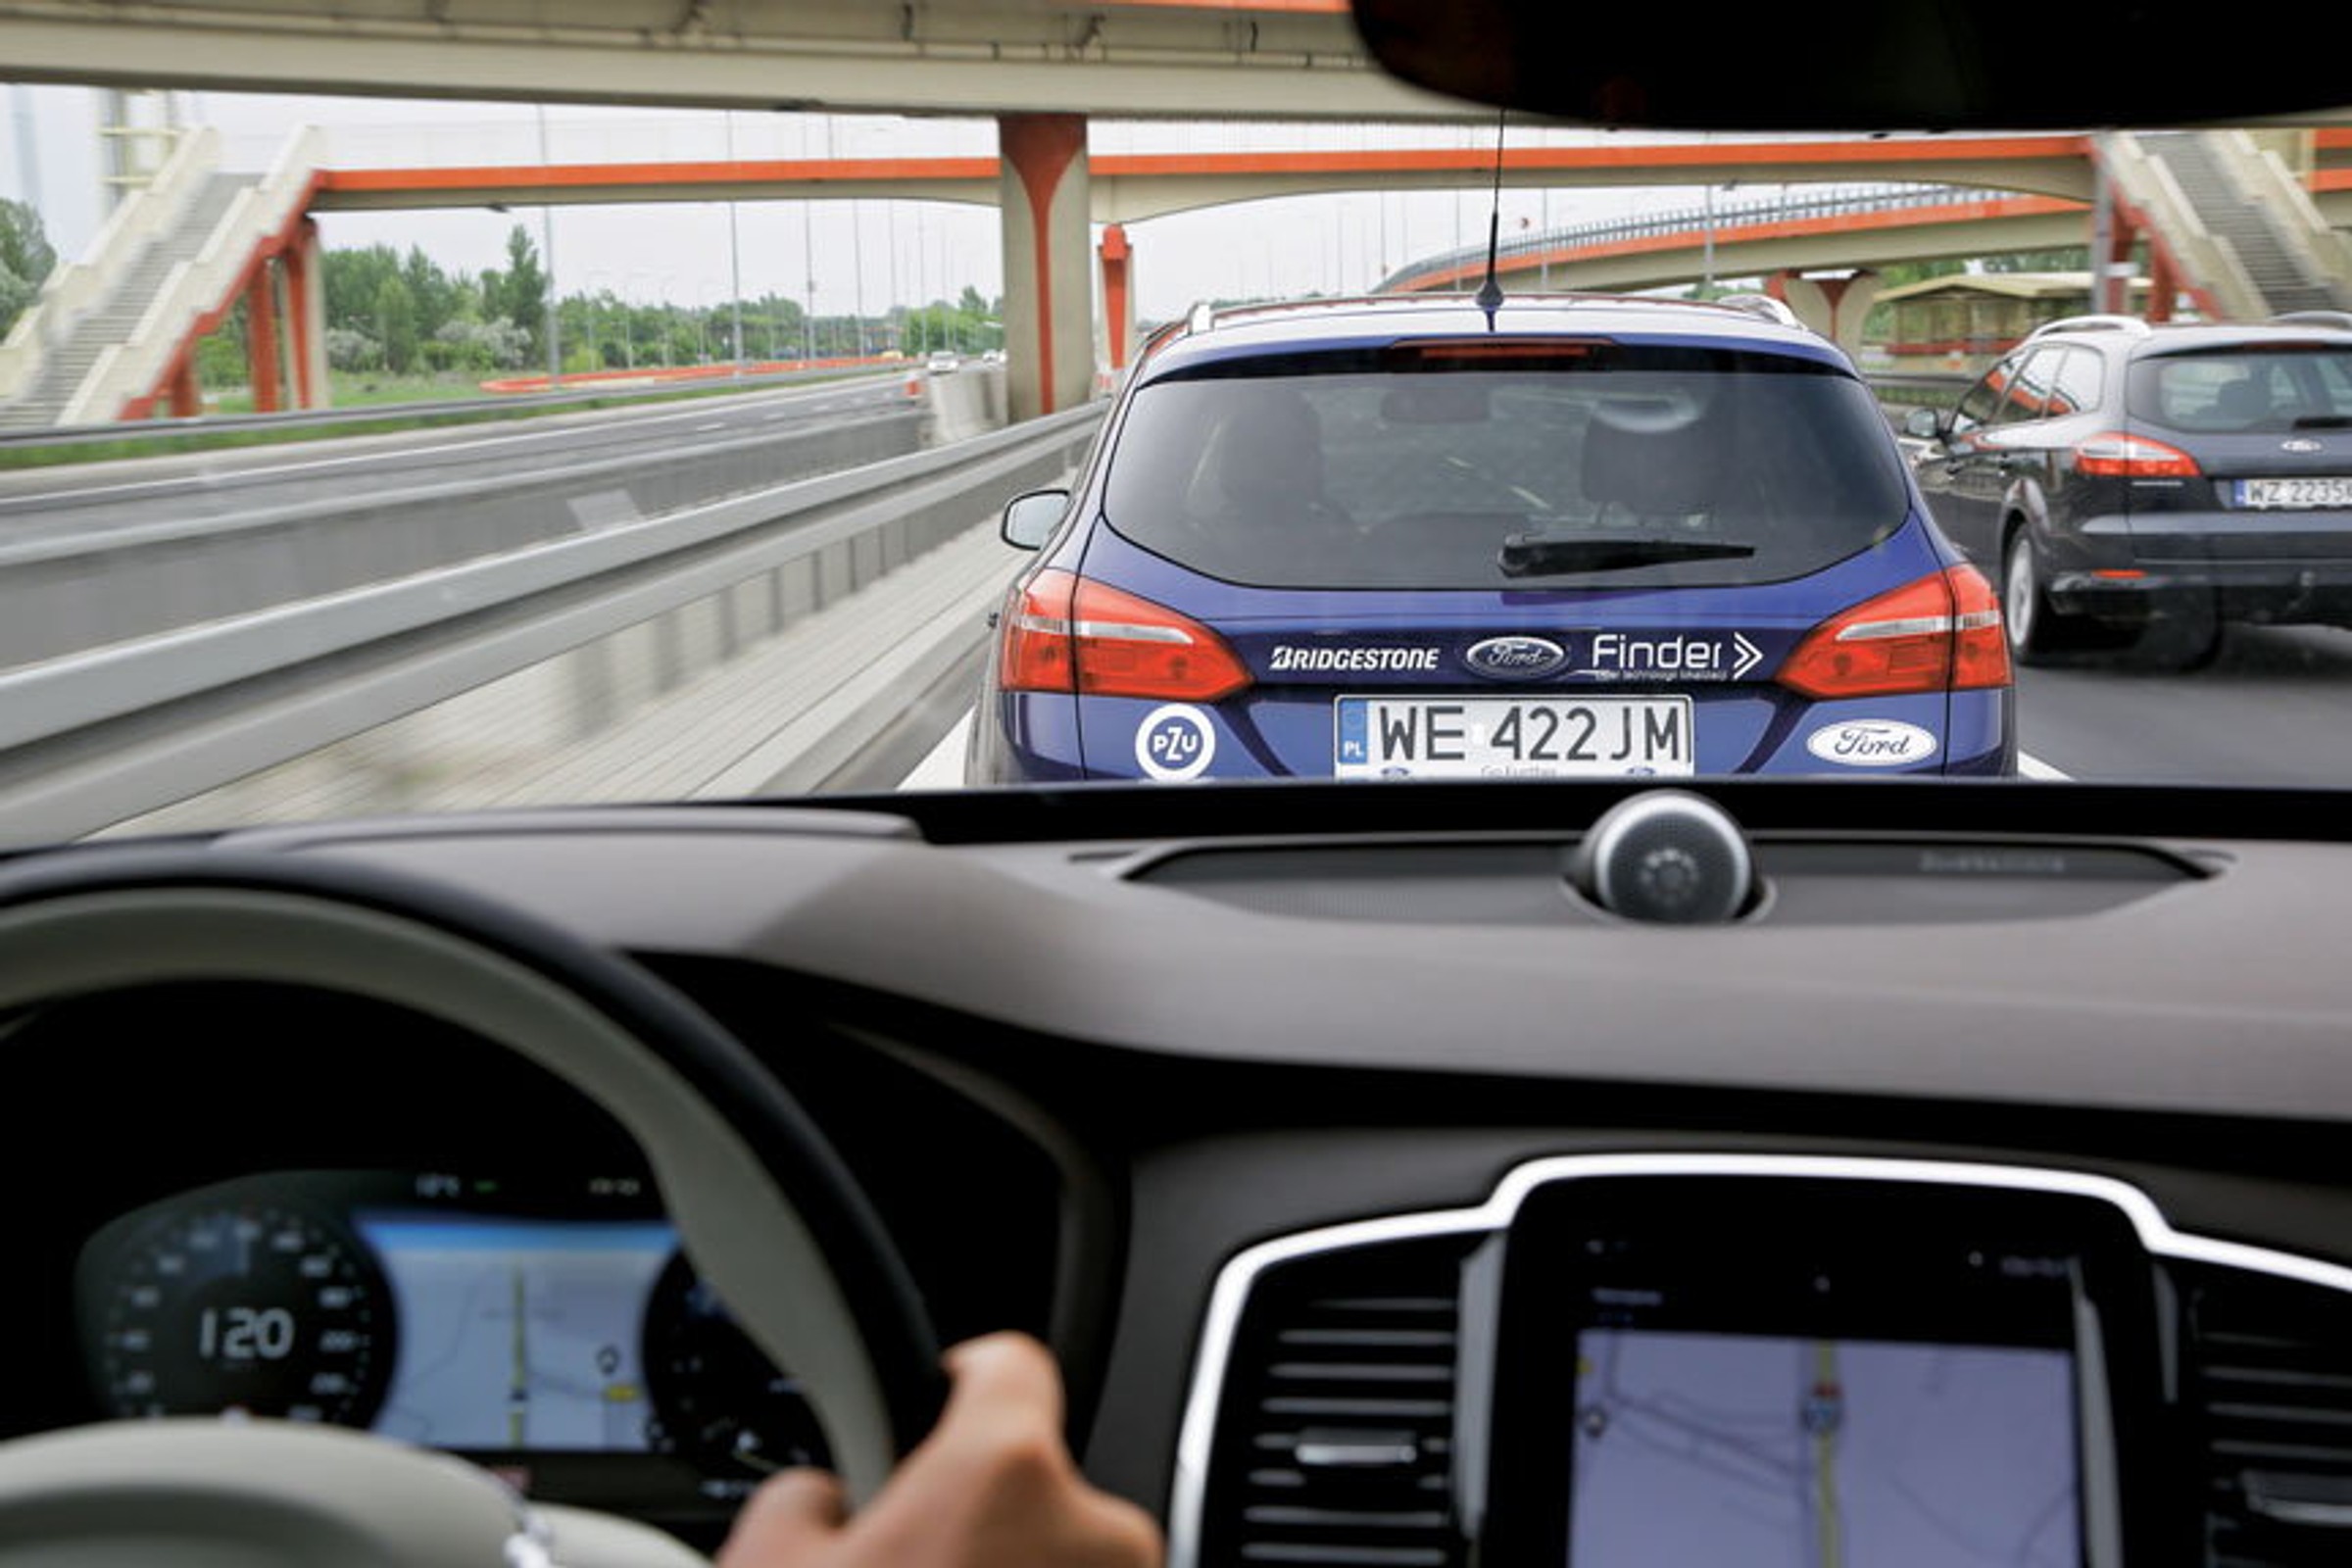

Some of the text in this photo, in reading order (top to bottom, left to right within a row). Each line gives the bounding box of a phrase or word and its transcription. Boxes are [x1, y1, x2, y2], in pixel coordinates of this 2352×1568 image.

[1269, 646, 1441, 670] BRIDGESTONE
[1592, 633, 1722, 668] Finder
[1153, 726, 1198, 760] PZU
[1344, 741, 1364, 758] PL
[1379, 705, 1680, 761] WE 422JM
[1834, 726, 1910, 755] Ford
[199, 1306, 294, 1360] 120
